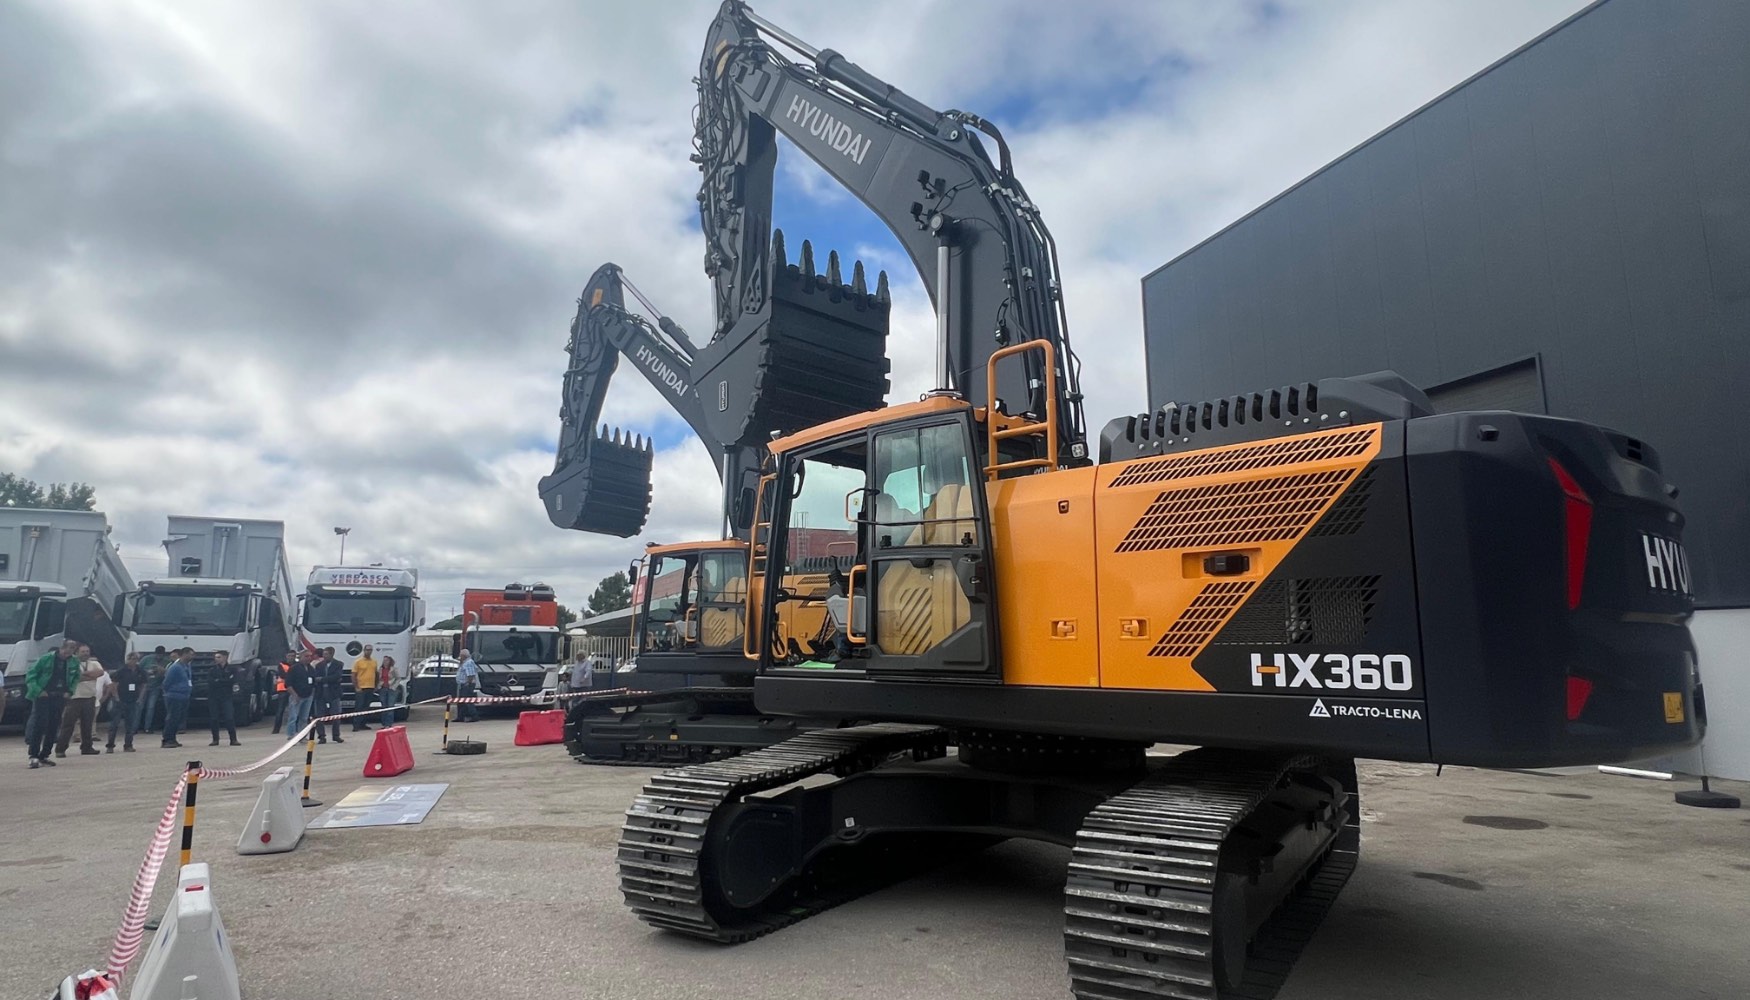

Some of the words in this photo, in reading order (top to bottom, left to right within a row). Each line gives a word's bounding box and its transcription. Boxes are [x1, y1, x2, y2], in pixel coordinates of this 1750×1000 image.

[786, 94, 872, 165] HYUNDAI
[636, 345, 688, 396] HYUNDAI
[1250, 653, 1413, 691] HX360
[1331, 705, 1422, 720] TRACTO-LENA
